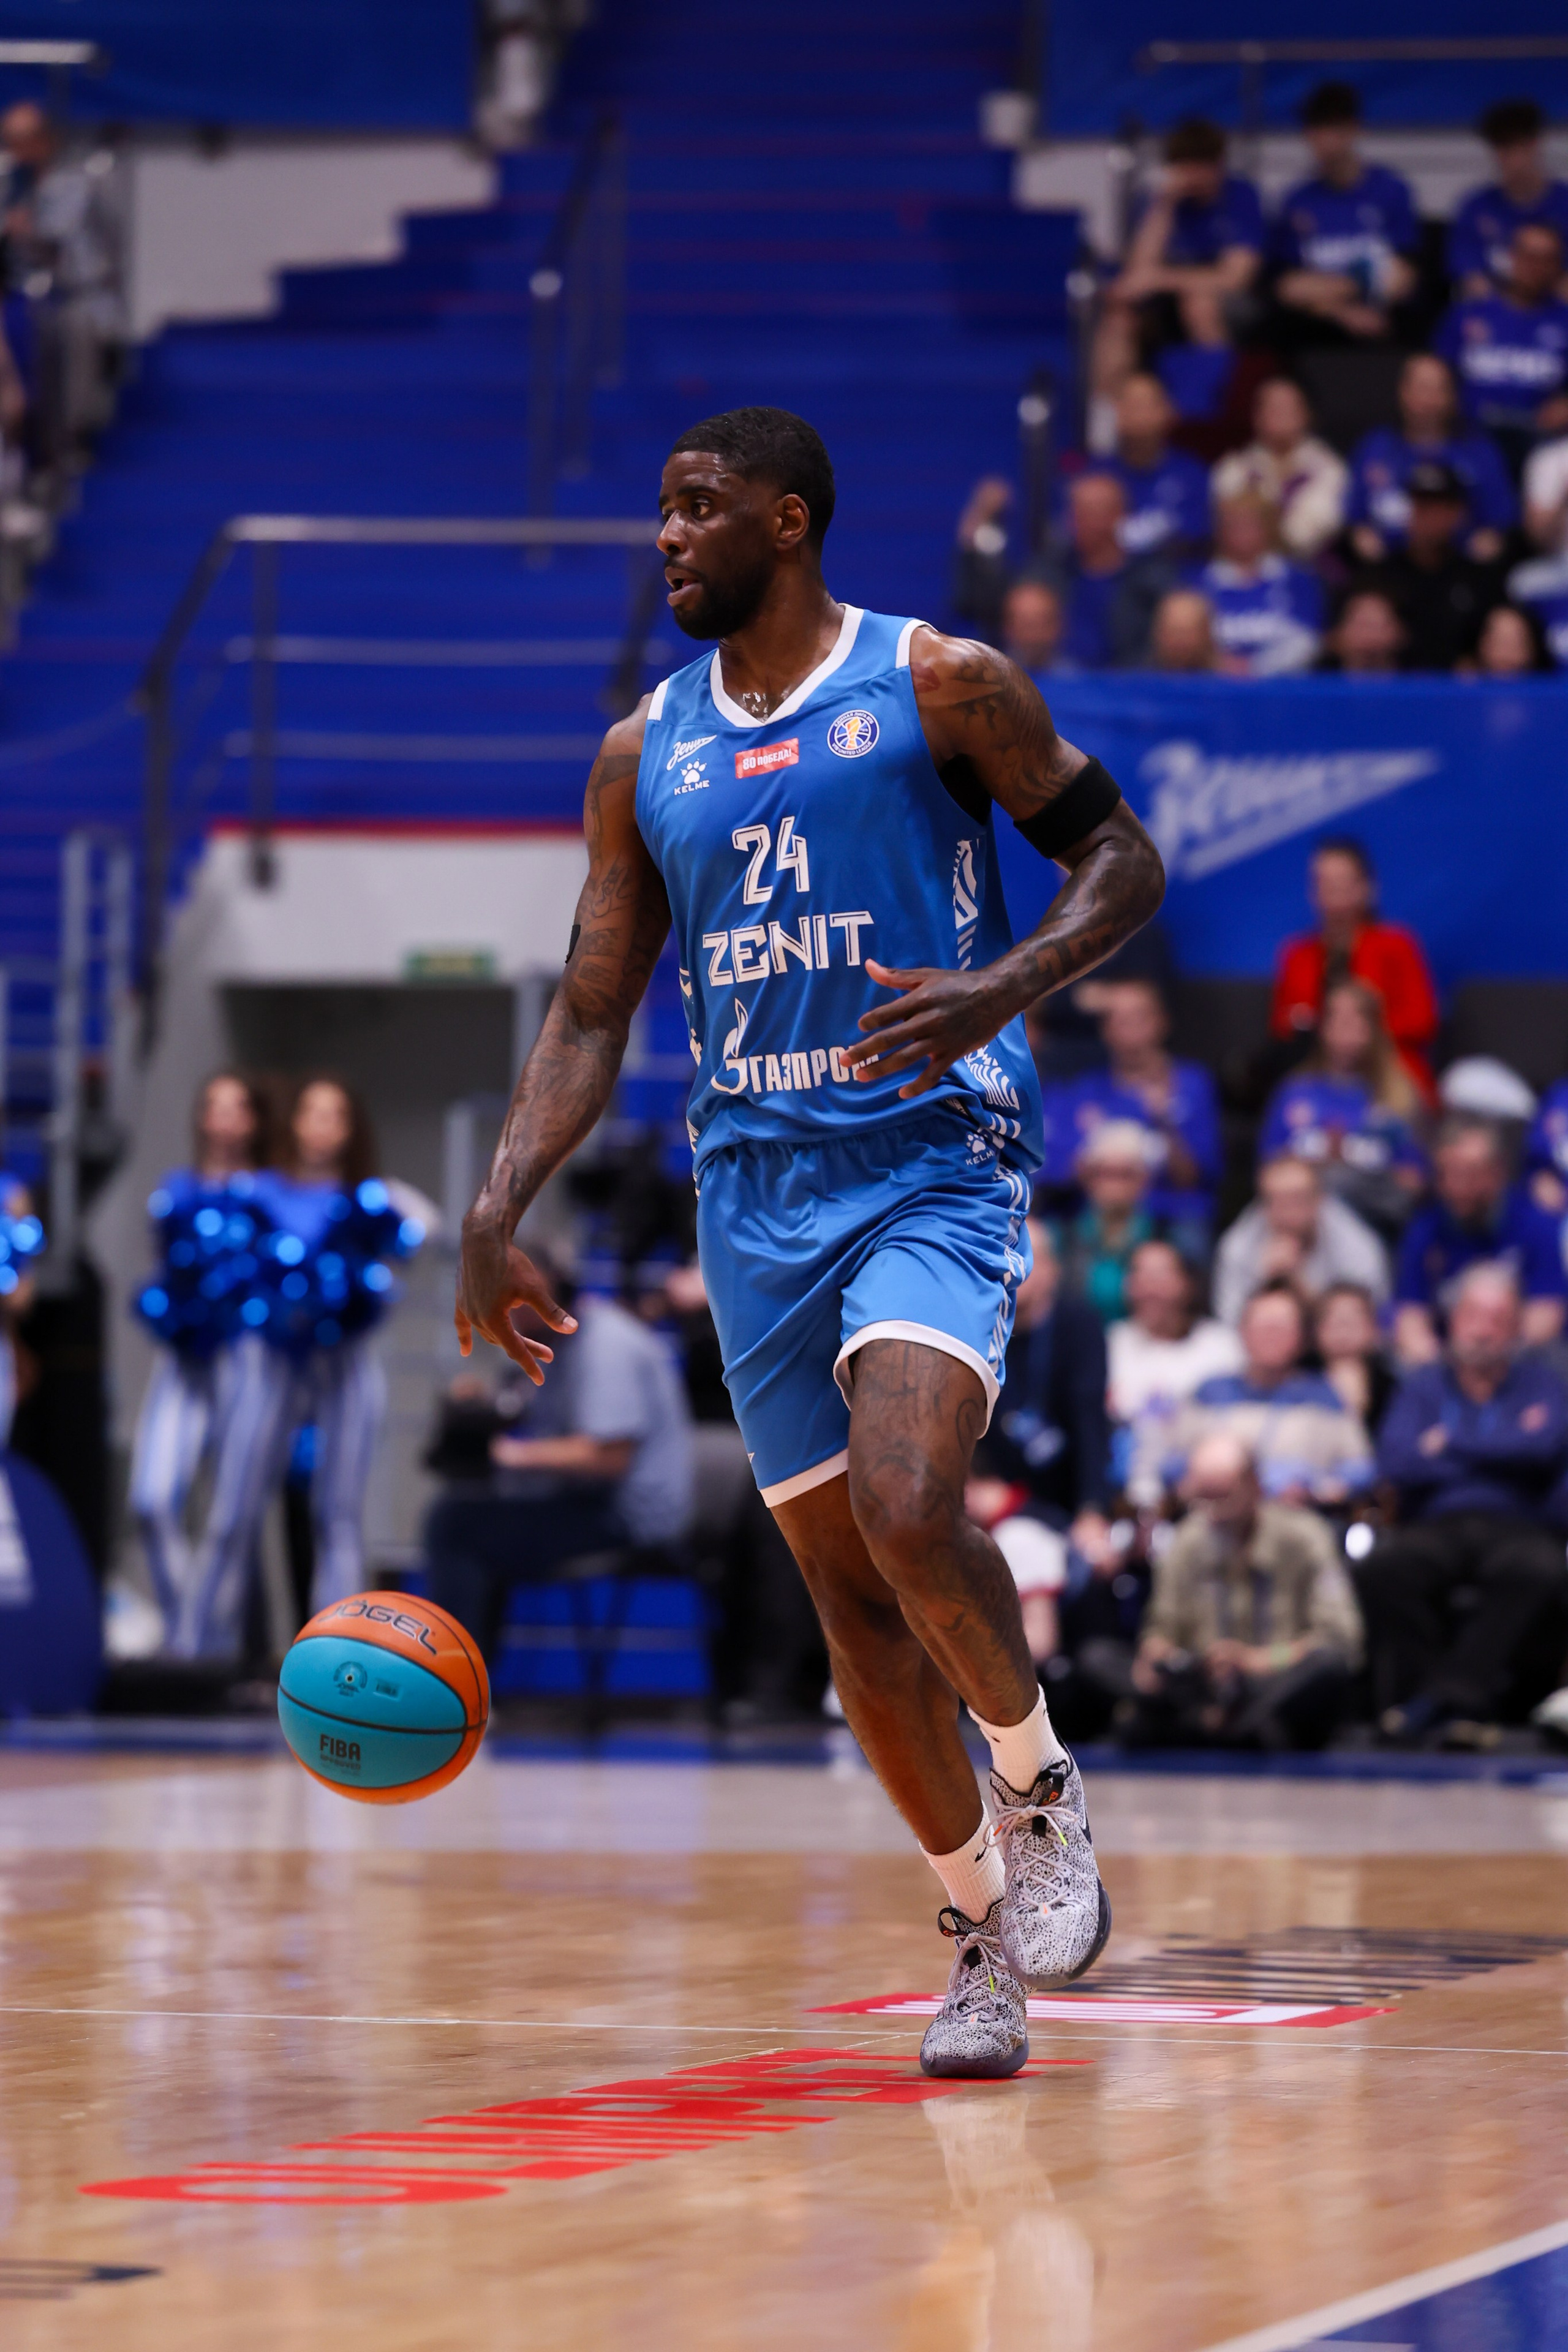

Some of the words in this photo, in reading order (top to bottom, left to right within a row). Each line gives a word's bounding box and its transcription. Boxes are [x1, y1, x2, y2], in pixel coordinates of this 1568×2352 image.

[742, 756, 756, 770] 80
[757, 748, 792, 766] ПОБЕДА!
[674, 780, 710, 796] KELME
[731, 815, 810, 905] 24
[702, 910, 874, 986] ZENIT
[965, 1150, 993, 1166] KELM
[320, 1733, 361, 1762] FIBA
[78, 2047, 1096, 2204] OLIMPBET
